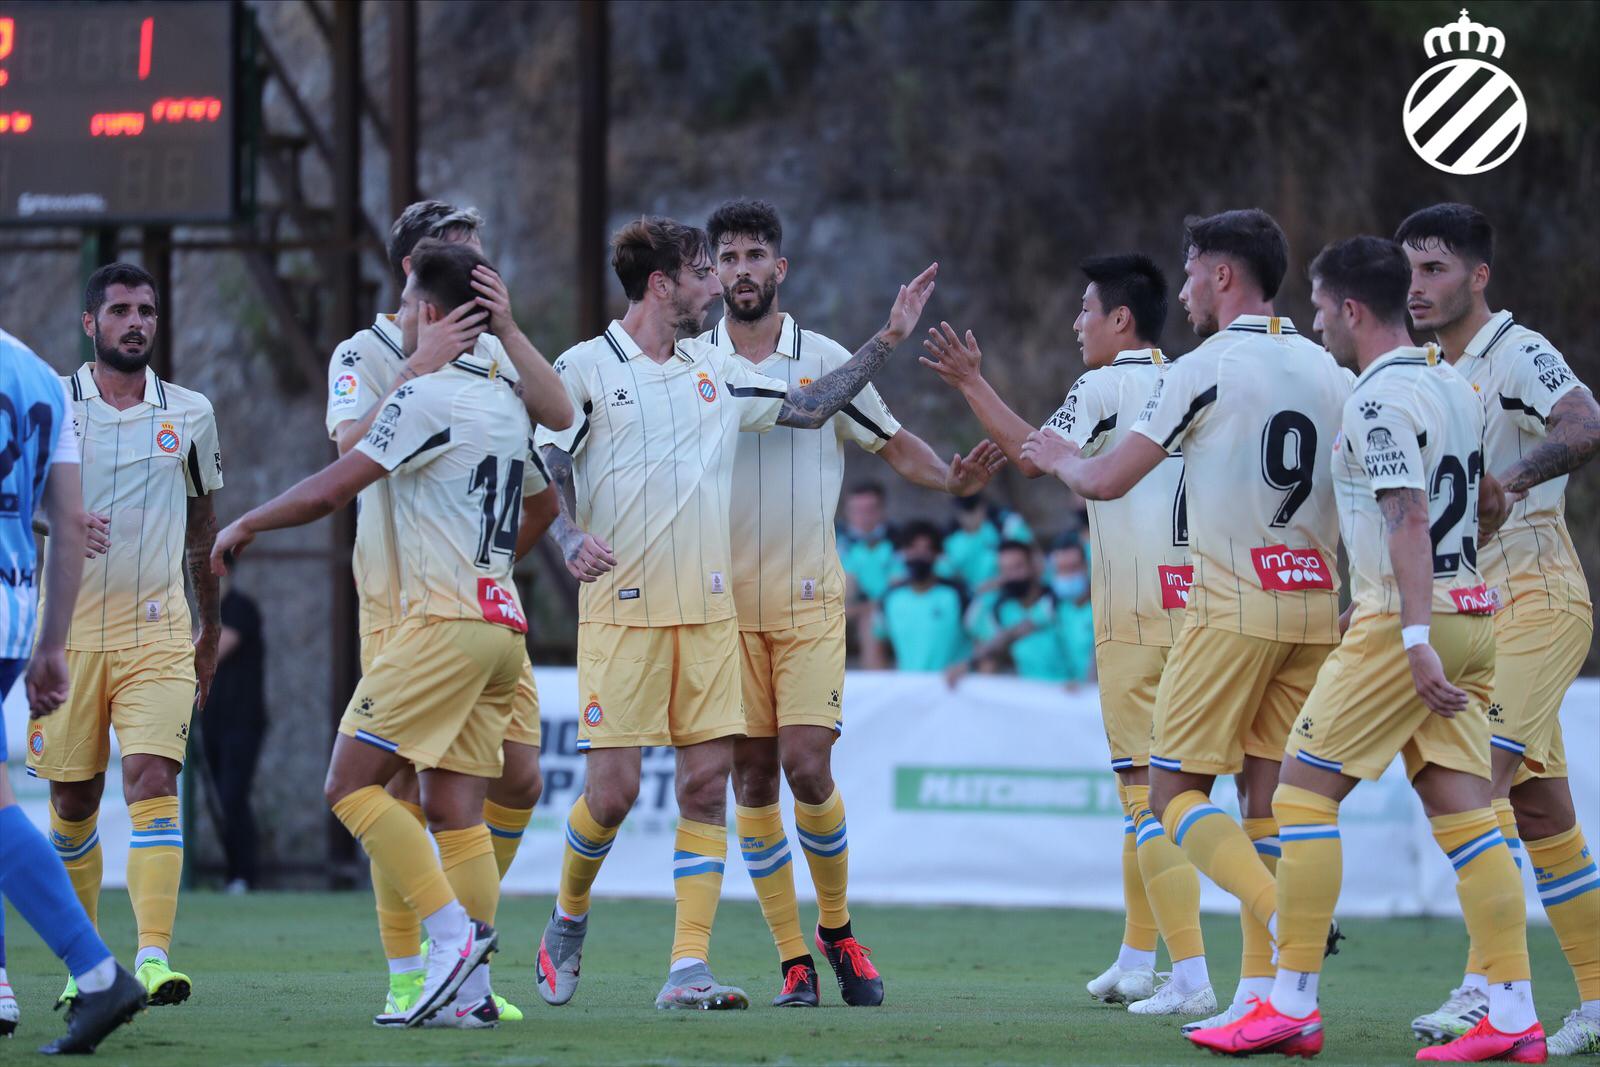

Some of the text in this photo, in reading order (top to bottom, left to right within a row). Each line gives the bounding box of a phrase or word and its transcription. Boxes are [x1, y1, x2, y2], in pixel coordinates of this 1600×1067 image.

[1261, 410, 1318, 528] 9
[1365, 451, 1406, 466] RIVIERA
[1367, 461, 1409, 480] MAYA
[467, 455, 524, 569] 14
